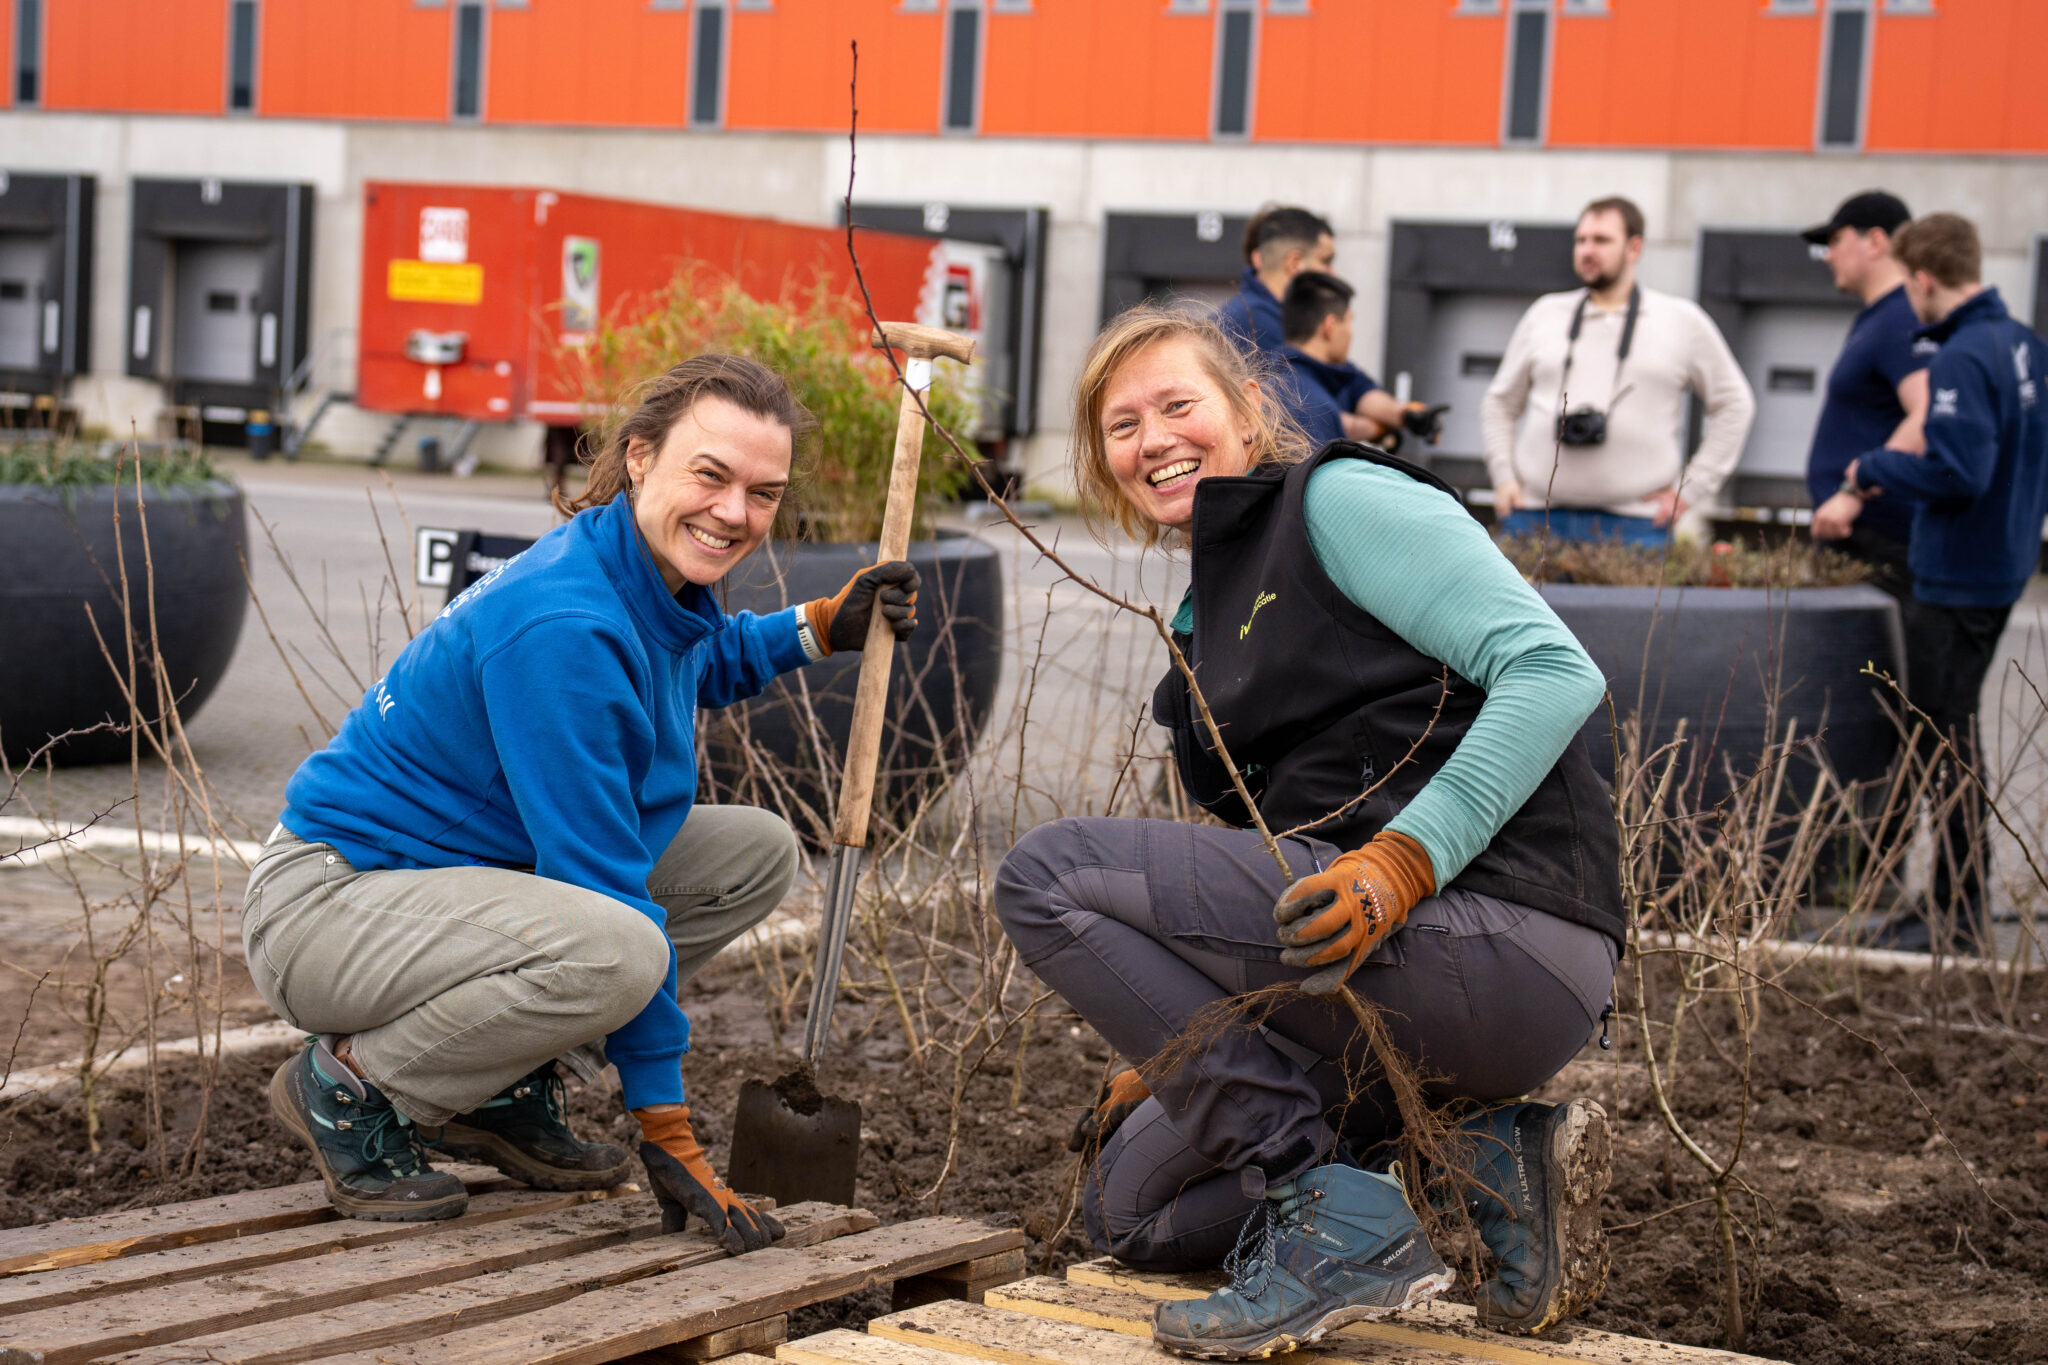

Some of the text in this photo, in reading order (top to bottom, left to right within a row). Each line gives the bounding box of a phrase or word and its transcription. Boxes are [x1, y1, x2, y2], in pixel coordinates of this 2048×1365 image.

[429, 539, 454, 577] P
[1517, 1155, 1529, 1192] ULTRA
[1522, 1193, 1531, 1203] X
[1382, 1238, 1416, 1267] SALOMON
